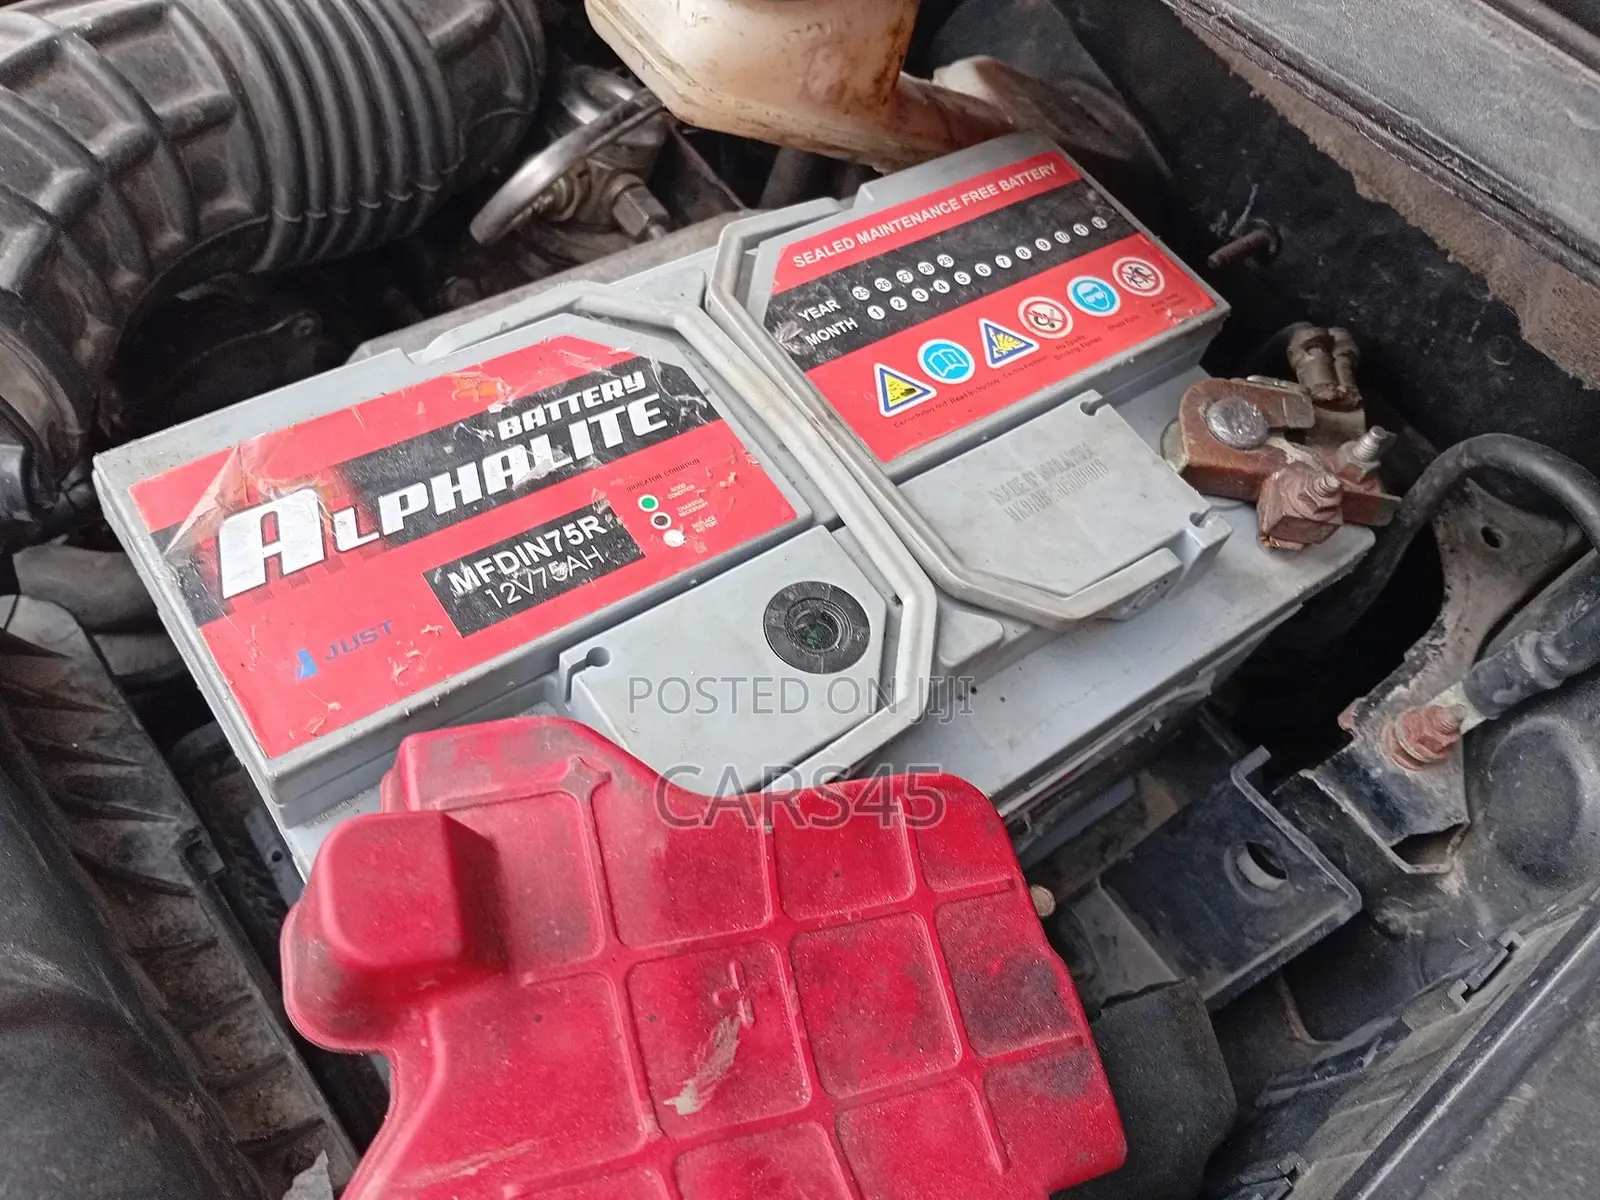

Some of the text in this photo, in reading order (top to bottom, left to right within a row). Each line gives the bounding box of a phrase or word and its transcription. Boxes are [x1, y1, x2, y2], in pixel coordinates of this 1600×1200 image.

[792, 163, 1057, 268] SEALED MAINTENANCE FREE BATTERY
[797, 255, 952, 322] YEAR 25 26 27 28 29
[804, 317, 859, 346] MONTH
[1055, 231, 1070, 243] 10
[1074, 224, 1088, 236] 11
[498, 370, 647, 442] BATTERY
[218, 393, 668, 600] ALPHALITE
[626, 458, 701, 493] INDICATOR CONDITION
[447, 514, 608, 598] MFDIN75R
[485, 544, 606, 609] 12V75AH
[325, 619, 394, 661] JUST
